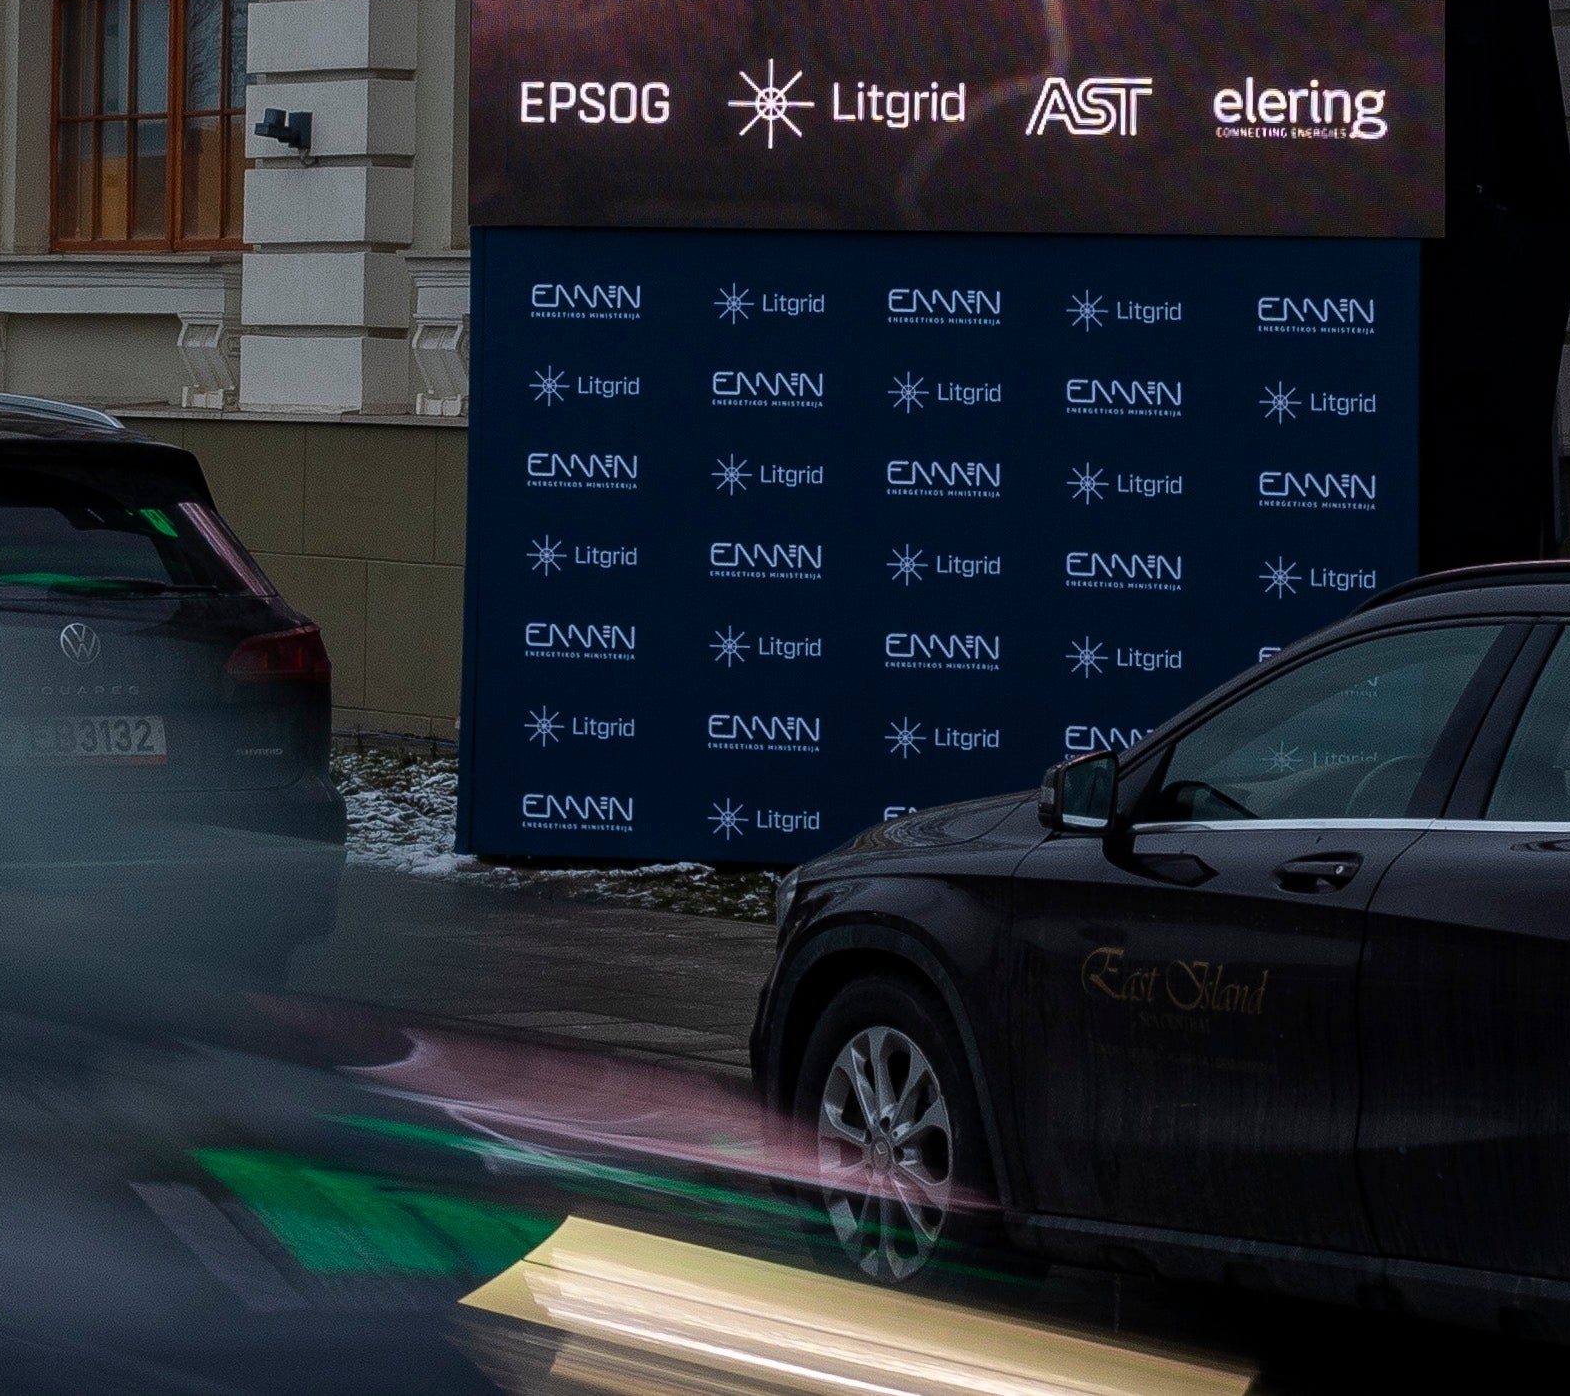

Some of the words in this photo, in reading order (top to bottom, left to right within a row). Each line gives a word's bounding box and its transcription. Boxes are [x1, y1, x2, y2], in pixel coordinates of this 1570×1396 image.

[519, 81, 670, 124] EPSOG
[832, 81, 966, 129] Litgrid
[1026, 76, 1153, 136] AST
[1213, 76, 1388, 140] elering
[762, 293, 825, 317] Litgrid
[1116, 300, 1182, 325] Litgrid
[577, 375, 641, 399] Litgrid
[937, 382, 1002, 406] Litgrid
[1310, 392, 1377, 416] Litgrid
[760, 464, 824, 488] Litgrid
[1117, 474, 1183, 498] Litgrid
[574, 545, 638, 569] Litgrid
[936, 554, 1001, 578] Litgrid
[1310, 567, 1377, 592] Litgrid
[758, 636, 822, 660] Litgrid
[1116, 647, 1183, 672] Litgrid
[572, 716, 636, 740] Litgrid
[934, 727, 1000, 751] Litgrid
[756, 809, 821, 833] Litgrid
[1080, 946, 1160, 1003] East
[1165, 959, 1269, 1015] Island
